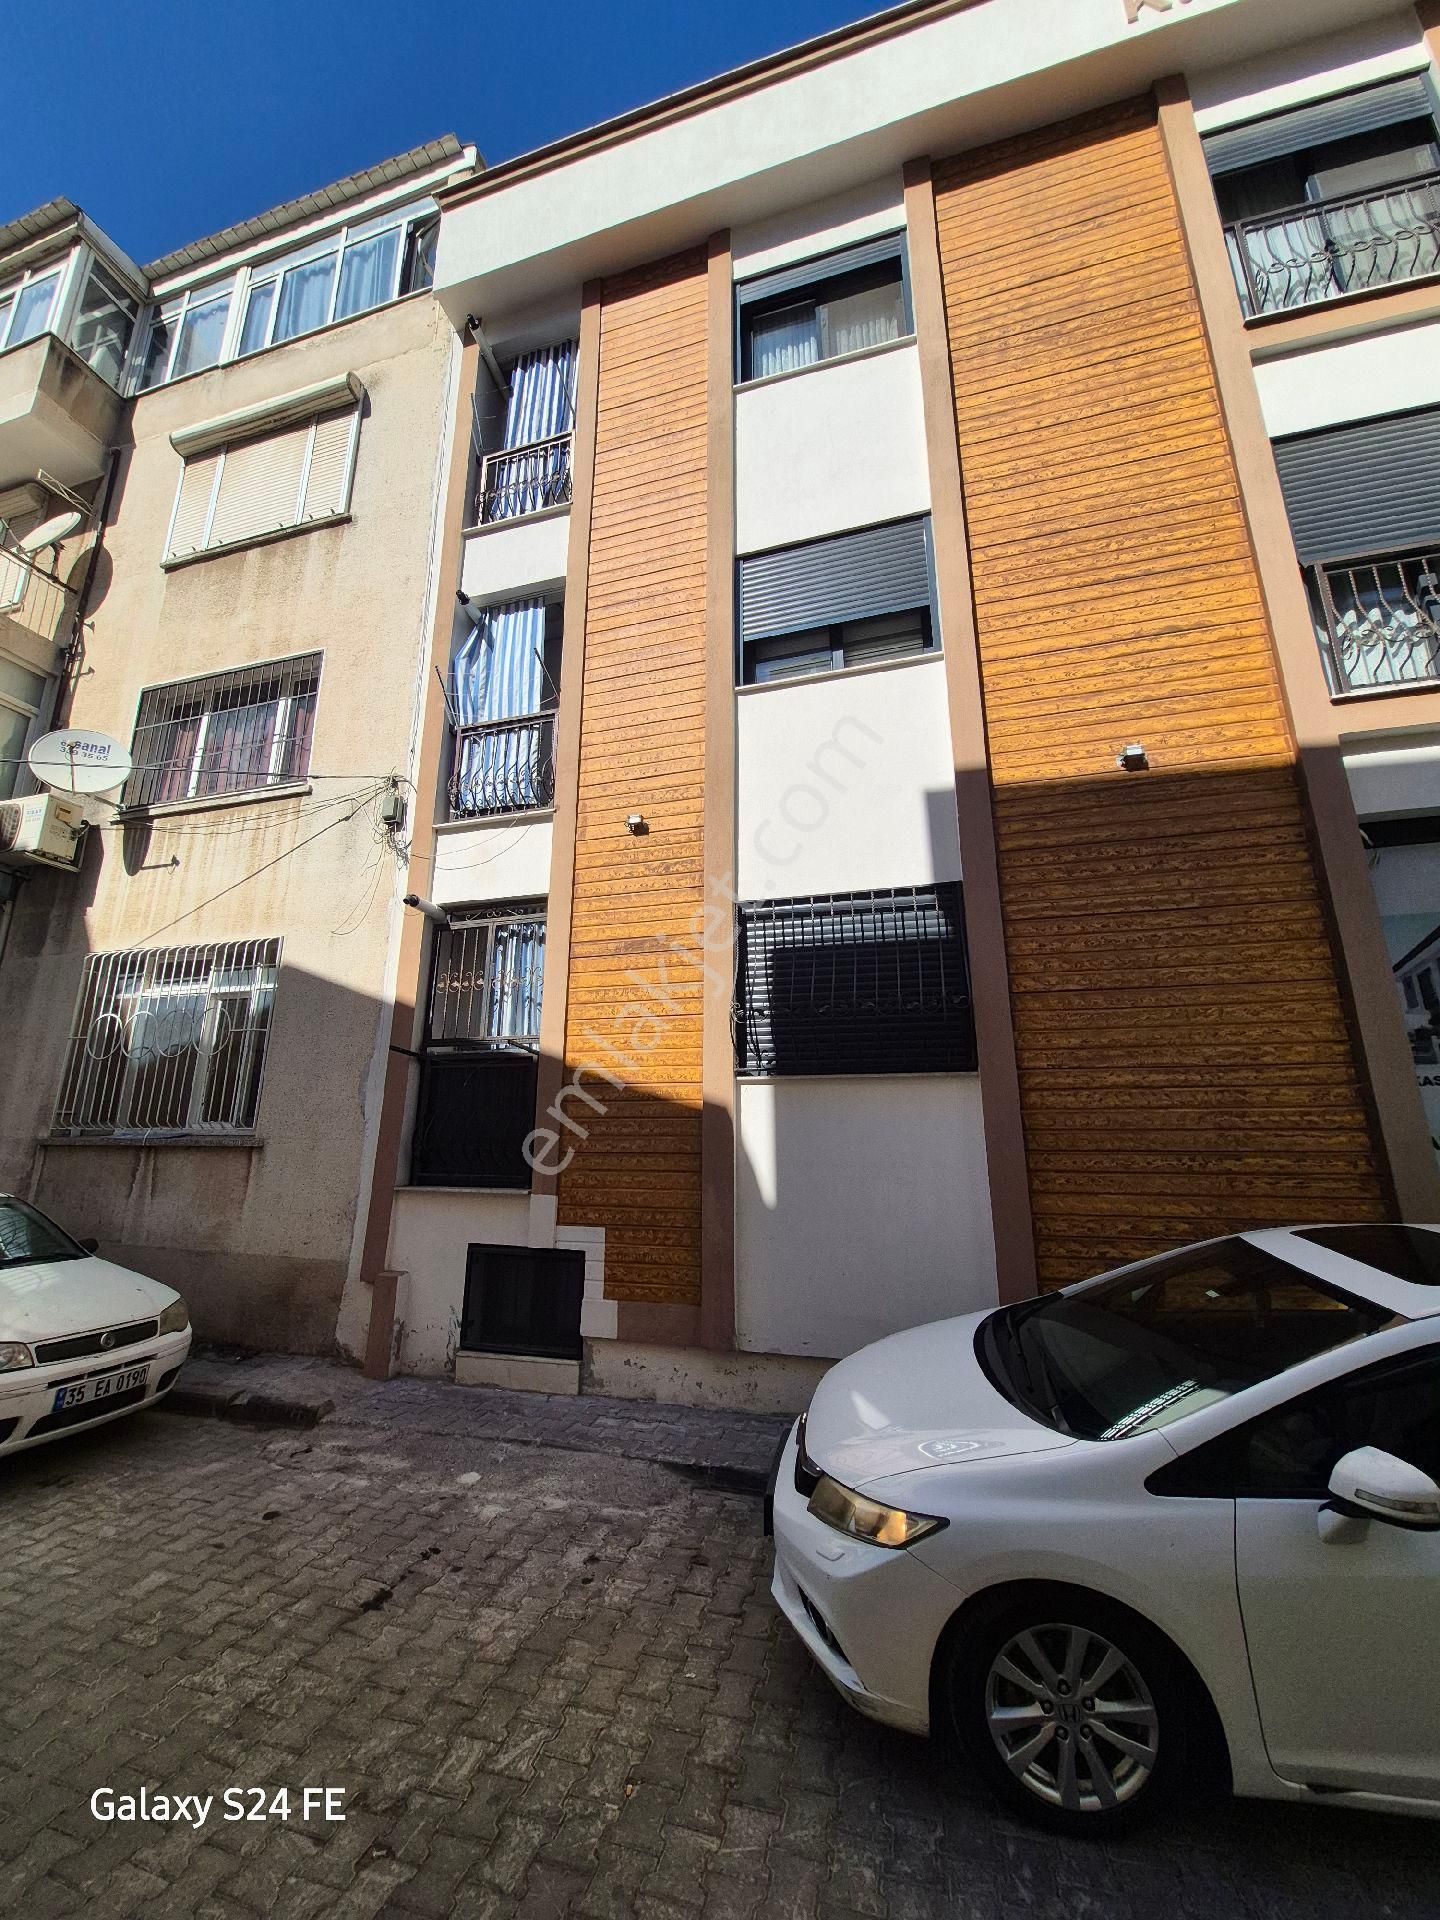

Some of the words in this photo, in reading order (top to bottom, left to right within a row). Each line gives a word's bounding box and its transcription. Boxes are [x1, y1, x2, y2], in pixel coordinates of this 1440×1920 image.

[65, 1385, 86, 1405] 35
[95, 1379, 111, 1397] EA
[116, 1367, 147, 1390] 0190
